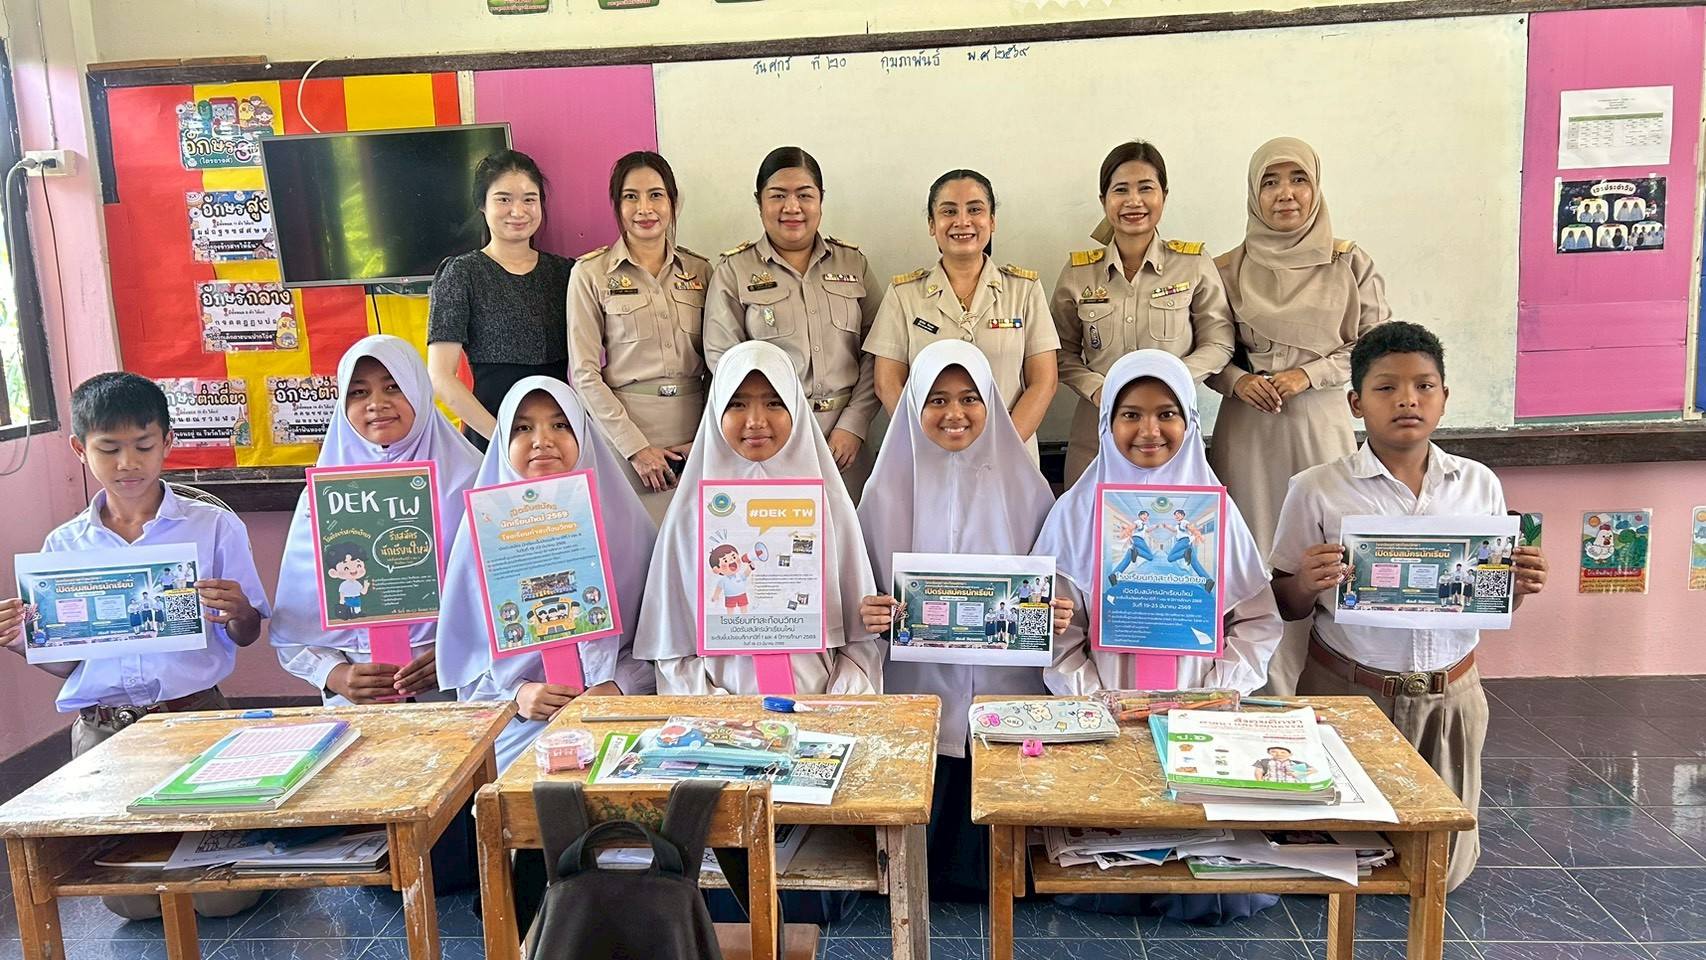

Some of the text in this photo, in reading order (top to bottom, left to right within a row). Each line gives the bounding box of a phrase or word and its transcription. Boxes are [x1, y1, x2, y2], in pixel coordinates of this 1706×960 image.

[202, 194, 270, 221] อักษรสูง
[201, 284, 292, 307] อักษรกลาง
[327, 491, 420, 519] DEK TW
[750, 508, 814, 518] #DEK TW
